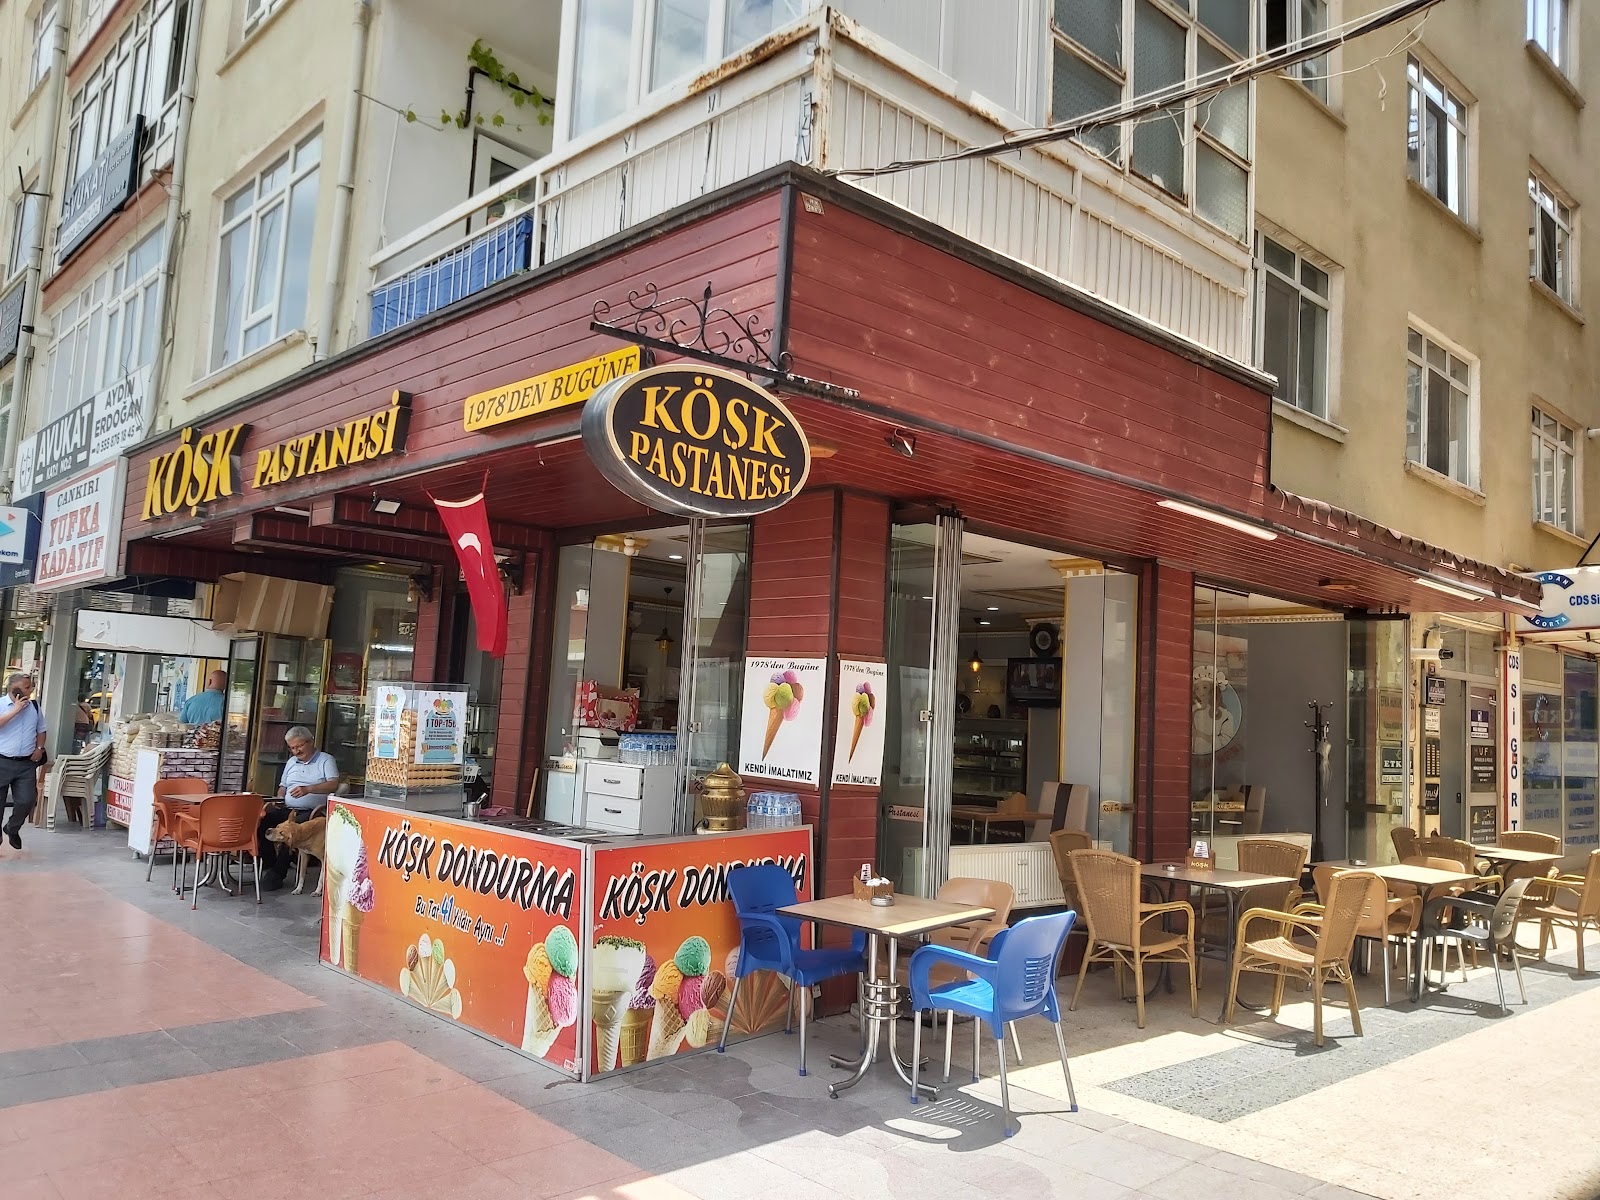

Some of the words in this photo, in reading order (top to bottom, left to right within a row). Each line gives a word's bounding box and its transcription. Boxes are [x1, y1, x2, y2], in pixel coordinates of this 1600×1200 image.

[63, 157, 107, 225] AVUKAT
[105, 377, 135, 410] AYDIN
[466, 381, 548, 425] 1978'DEN
[550, 354, 638, 401] BUGÜNE
[37, 402, 92, 470] AVUKAT
[94, 396, 143, 438] ERDOĞAN
[639, 376, 787, 459] KÖŞK
[140, 423, 246, 521] KÖŞK
[252, 389, 400, 489] PASTANESİ
[57, 477, 99, 511] ÇANKIRI
[49, 502, 99, 547] YUFKA
[39, 535, 104, 580] KADAYIF
[1569, 594, 1590, 606] CDS
[786, 661, 820, 672] Bugüne
[1508, 654, 1519, 670] CDS
[744, 763, 767, 775] KENDİ
[768, 764, 812, 781] İMALATIMIZ
[835, 773, 851, 782] KENDİ
[851, 773, 878, 785] İMALATIMIZ
[888, 805, 920, 818] Pastanesi
[378, 819, 436, 882] KÖŞK
[436, 839, 576, 921] DONDURMA
[600, 861, 677, 926] KÖŞK
[415, 896, 426, 916] Bu
[428, 899, 440, 919] Tat
[440, 892, 454, 924] 41
[473, 916, 494, 944] Aynı
